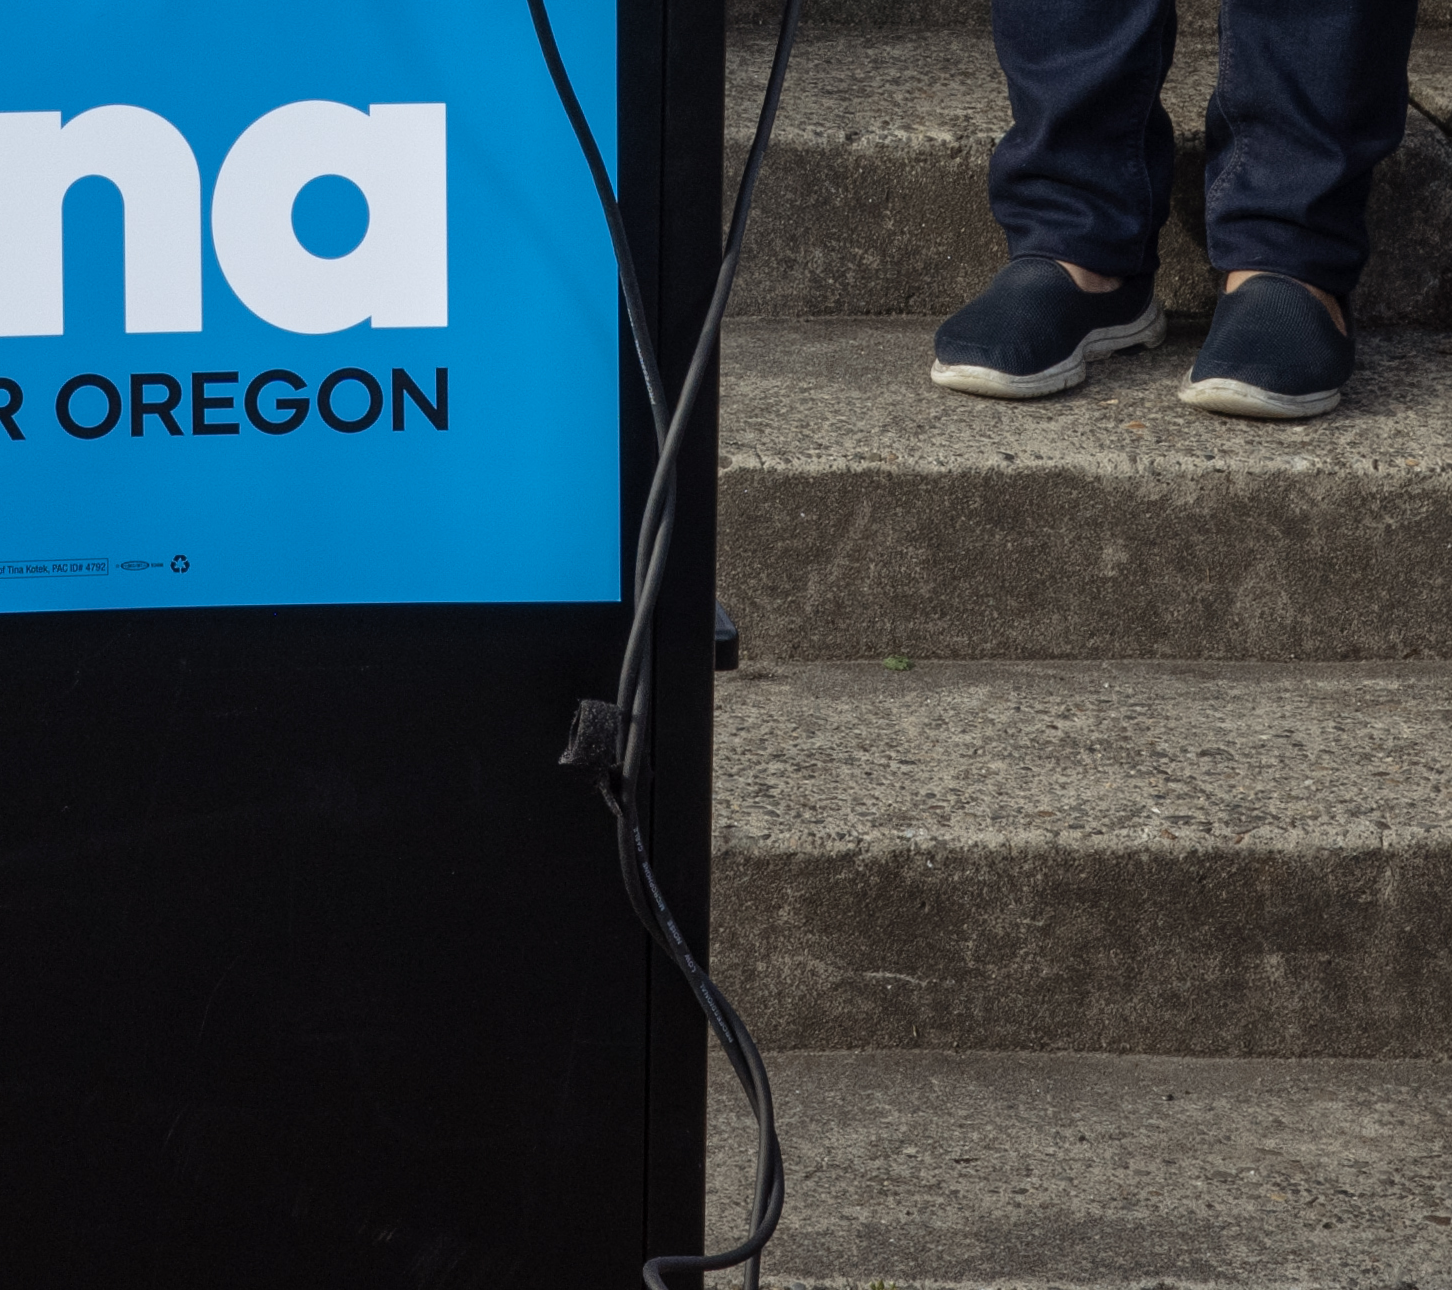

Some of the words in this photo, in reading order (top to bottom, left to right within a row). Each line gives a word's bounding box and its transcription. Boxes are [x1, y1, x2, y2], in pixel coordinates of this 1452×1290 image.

[56, 368, 448, 439] OREGON
[7, 565, 23, 574] Tina
[25, 564, 50, 574] Kotek,
[52, 563, 68, 573] PAC
[70, 563, 84, 573] ID#
[85, 562, 106, 572] 4792
[642, 861, 665, 912] MICROPHONE
[684, 953, 697, 973] LOW
